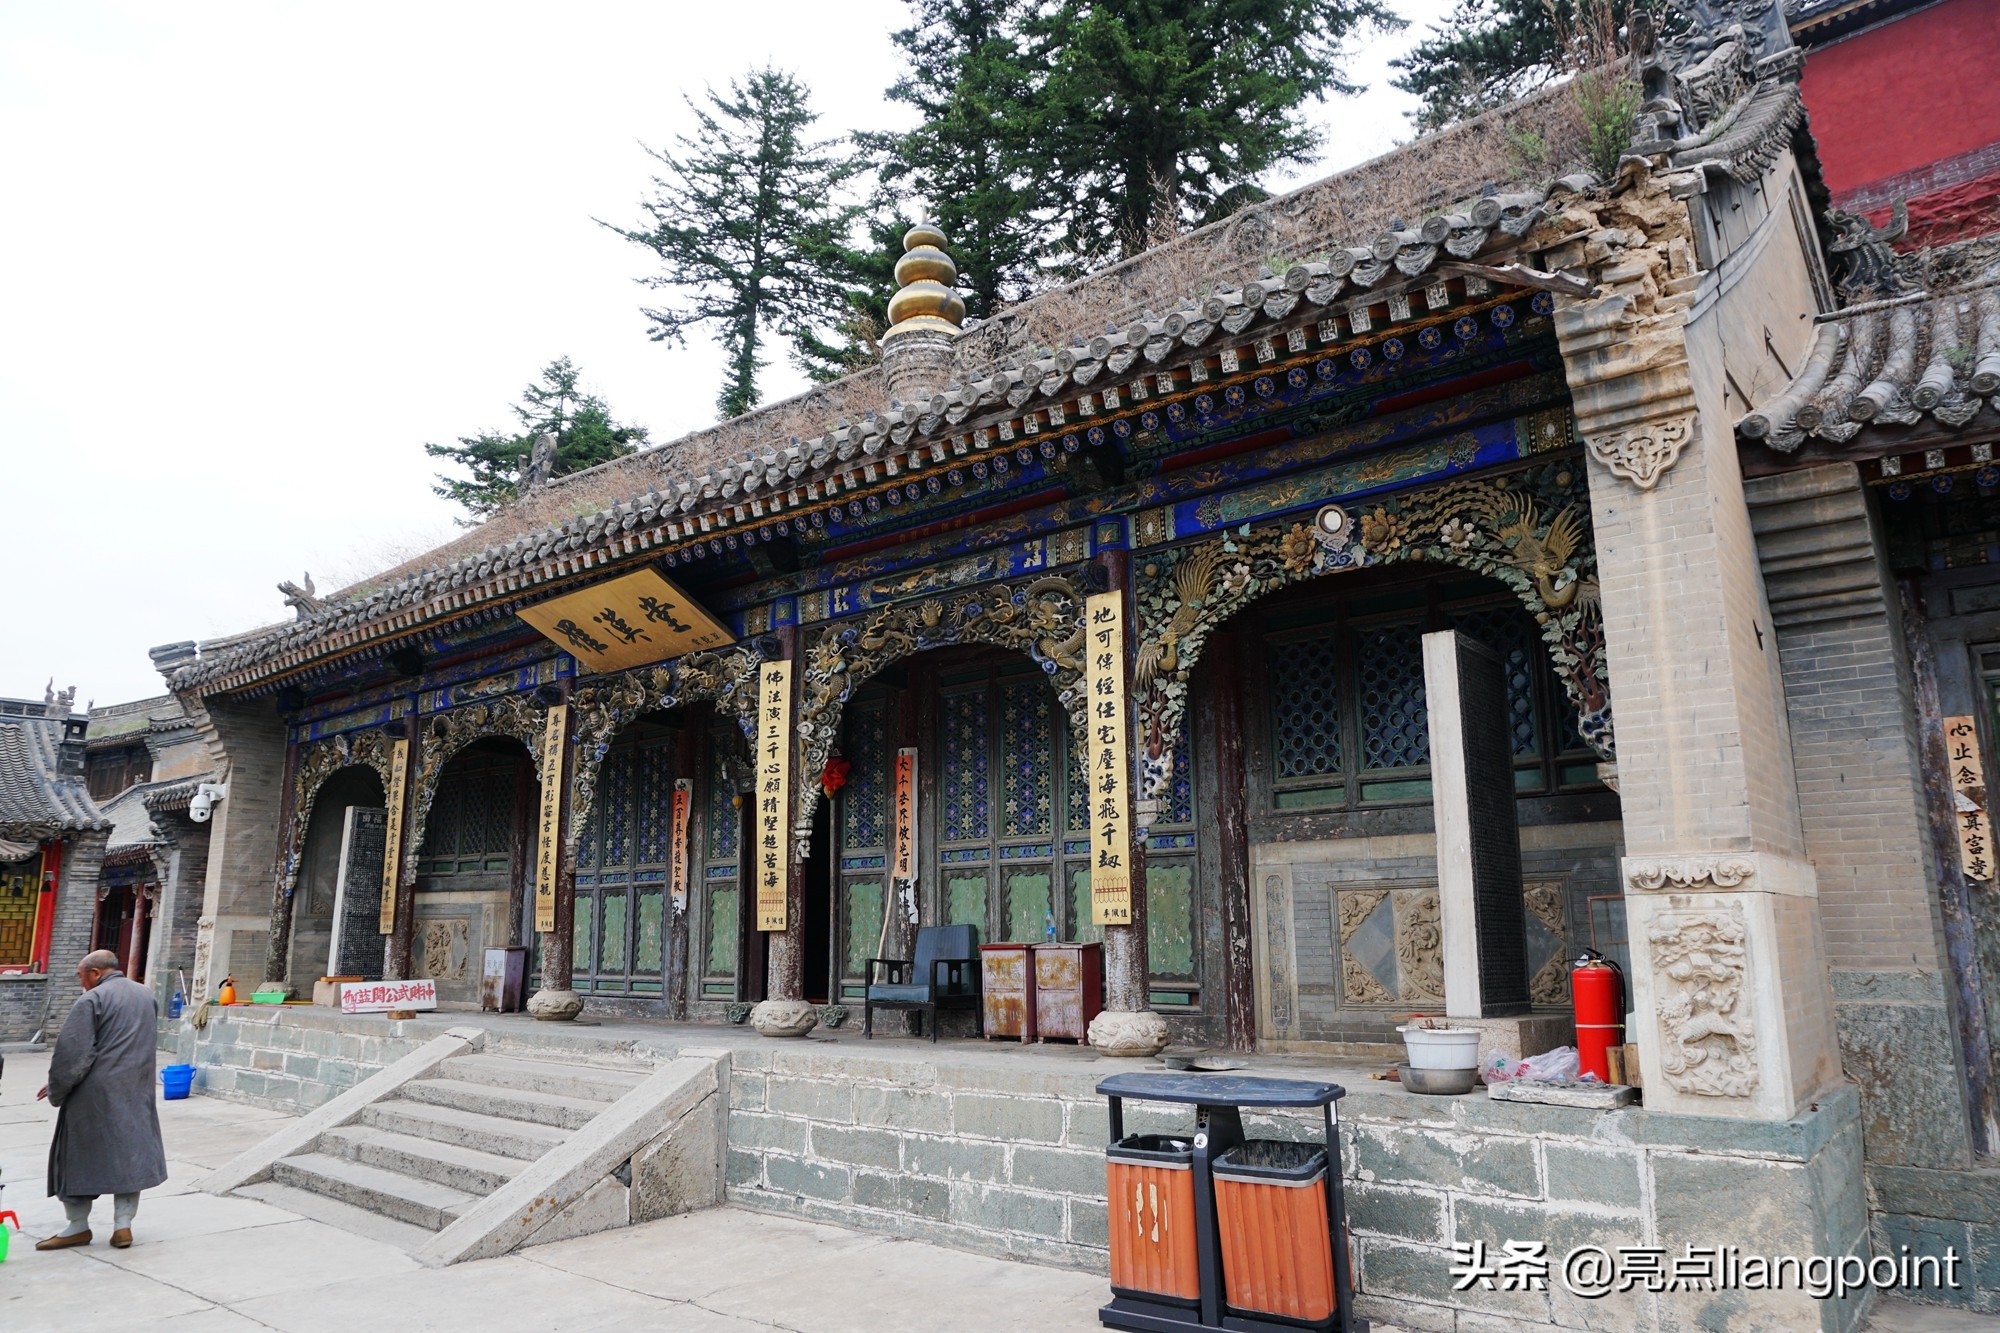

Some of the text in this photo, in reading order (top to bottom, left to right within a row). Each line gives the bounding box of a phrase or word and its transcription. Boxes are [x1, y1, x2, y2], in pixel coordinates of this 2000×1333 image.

[553, 596, 692, 656] 羅漢堂
[898, 758, 910, 873] 大千世界放光明
